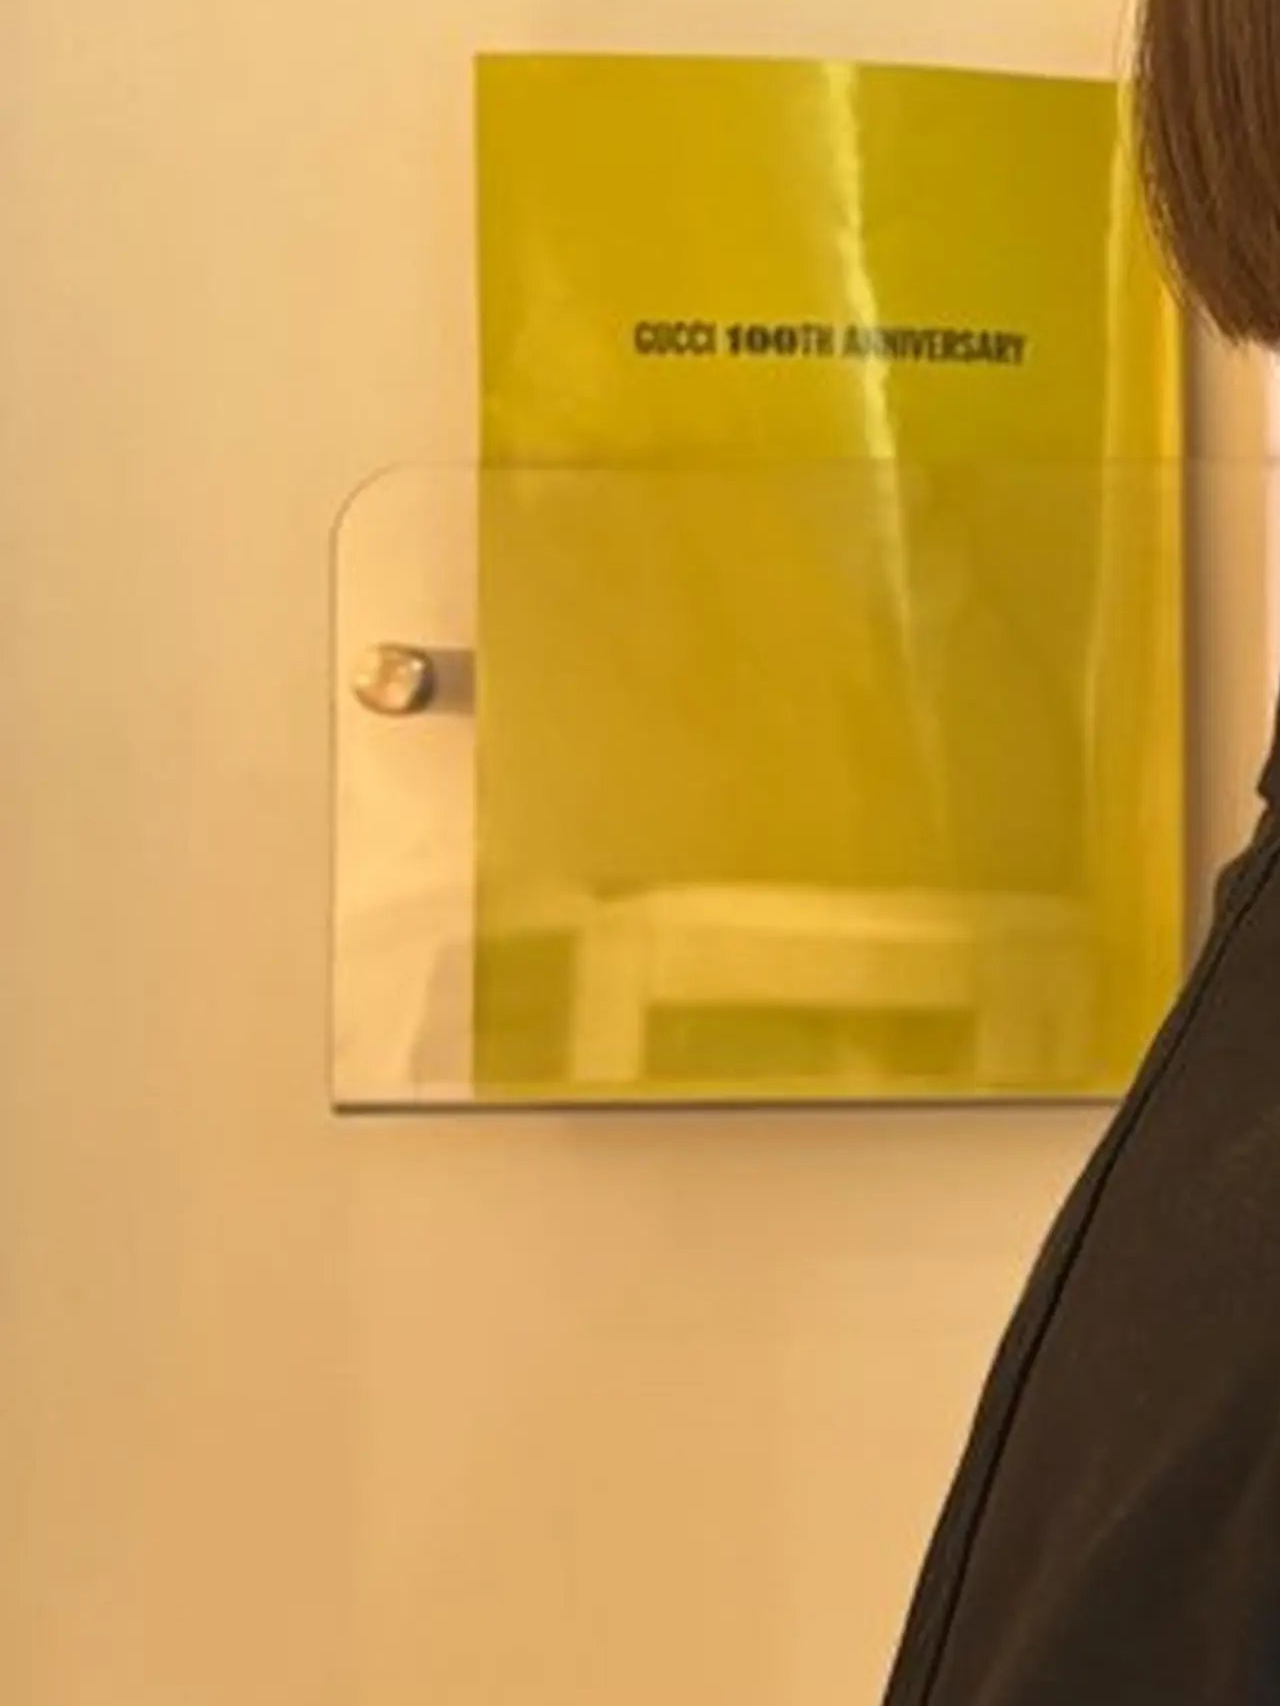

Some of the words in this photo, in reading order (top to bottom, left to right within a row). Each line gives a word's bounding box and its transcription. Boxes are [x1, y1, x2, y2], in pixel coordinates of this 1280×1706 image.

[634, 319, 718, 356] GUCCI
[726, 321, 835, 358] 100TH
[842, 325, 1026, 366] ANNIVERSARY
